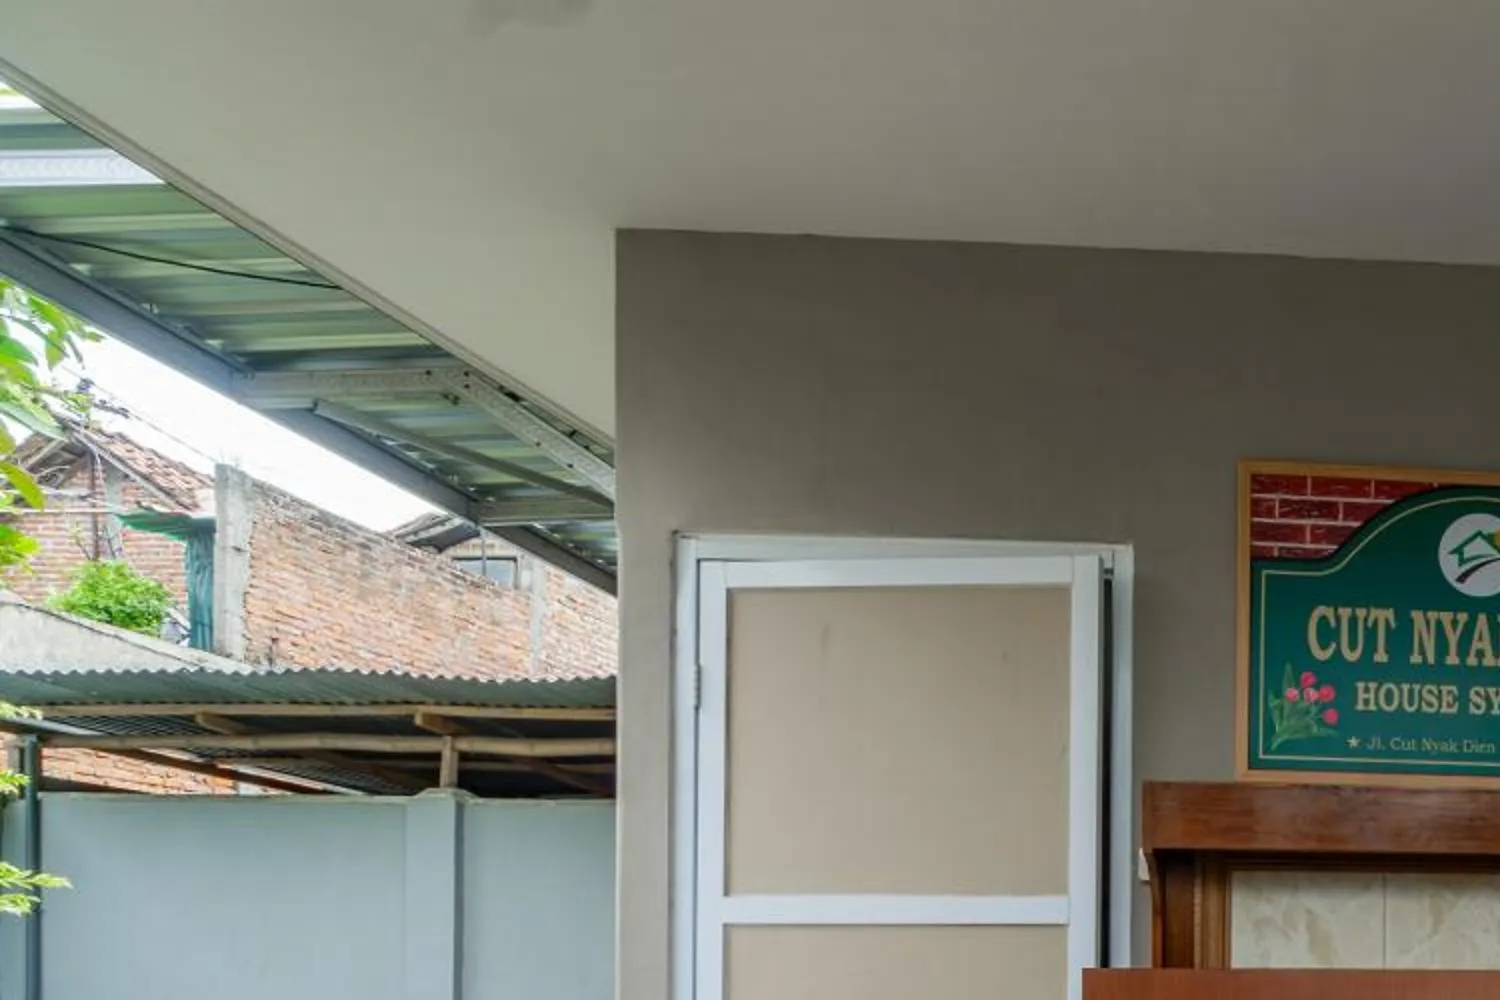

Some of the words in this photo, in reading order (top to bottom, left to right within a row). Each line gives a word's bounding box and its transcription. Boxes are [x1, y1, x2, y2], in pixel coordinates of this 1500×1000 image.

[1307, 605, 1396, 663] CUT
[1355, 681, 1459, 714] HOUSE
[1389, 737, 1415, 751] Cut
[1421, 738, 1459, 756] Nyak
[1463, 738, 1495, 753] Dien
